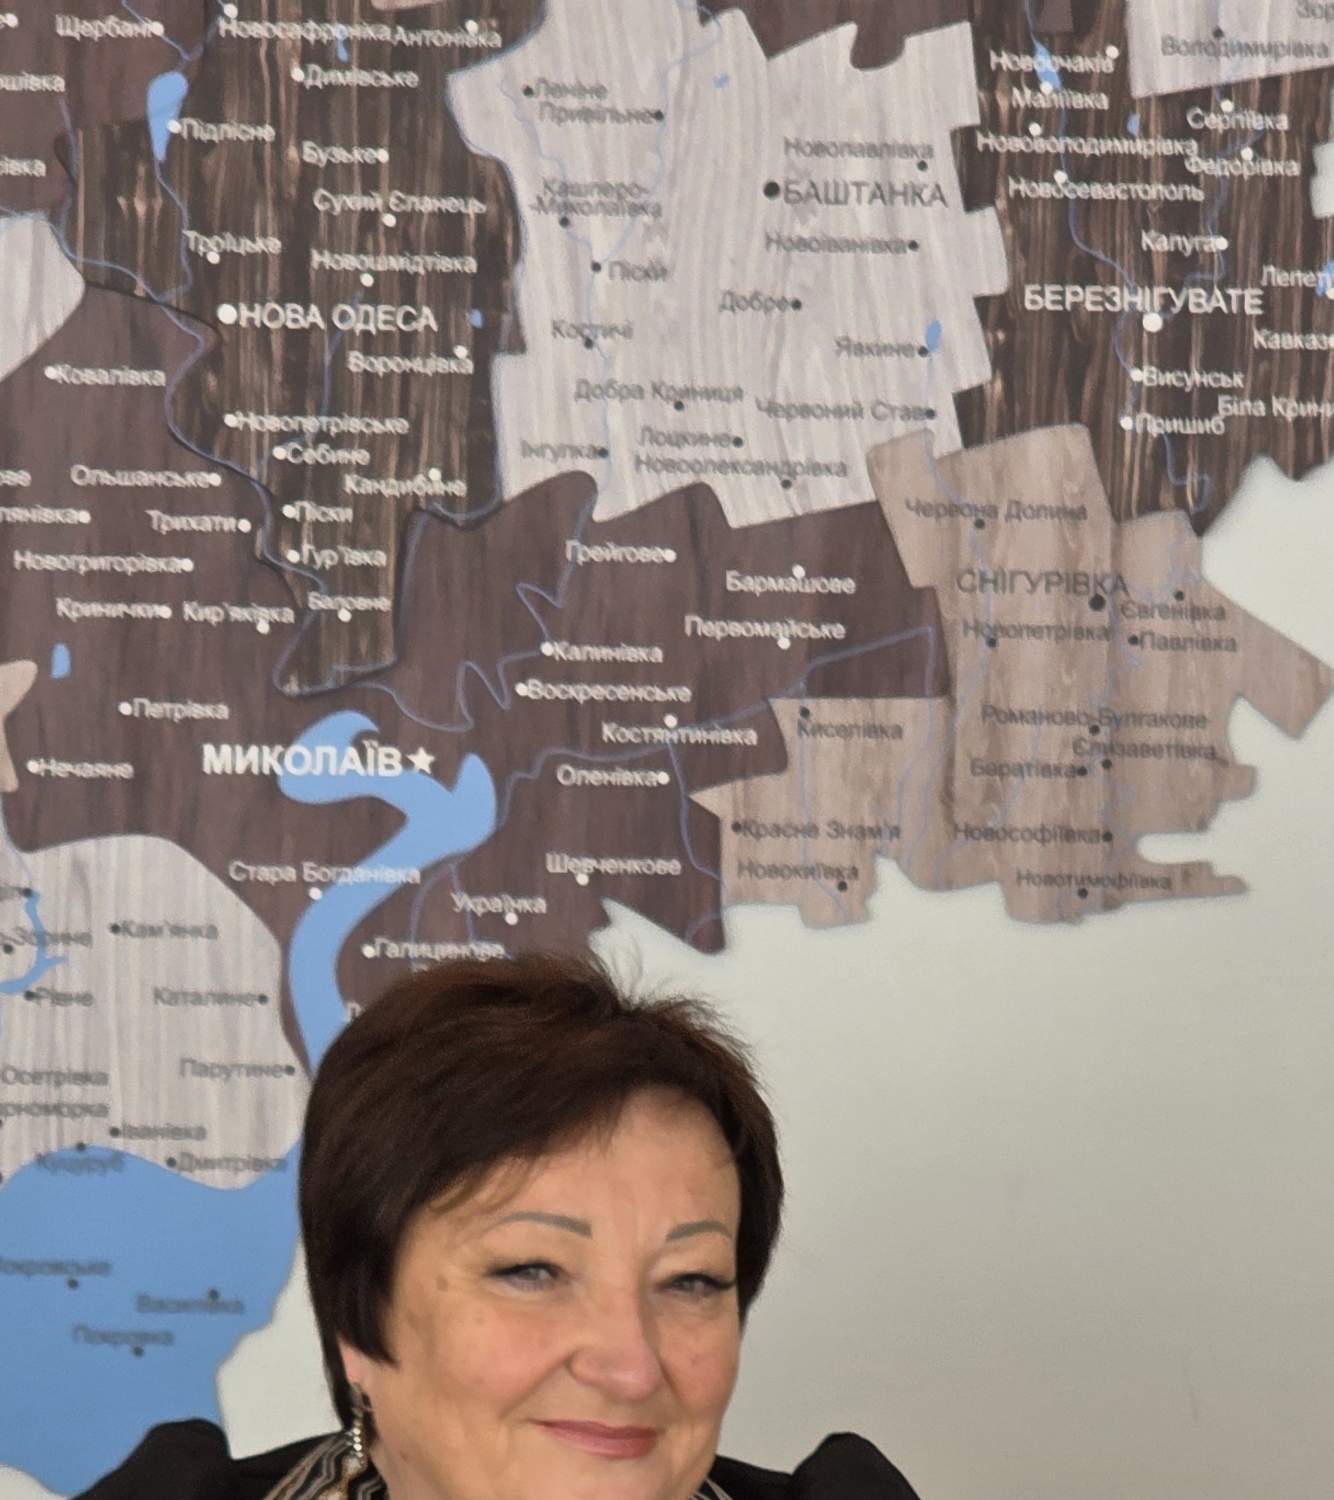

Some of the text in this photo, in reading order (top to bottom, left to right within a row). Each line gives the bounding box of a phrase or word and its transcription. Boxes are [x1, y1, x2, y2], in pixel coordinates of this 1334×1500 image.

[784, 182, 948, 208] БАШТАНКА
[1008, 179, 1204, 202] Новосевастополь
[1142, 231, 1215, 253] Калуга
[1025, 285, 1264, 315] БЕРЕЗНІГУВАТЕ
[240, 304, 437, 331] НОВА ОДЕСА
[1255, 330, 1330, 350] Кавказ
[1143, 367, 1244, 388] Висунськ
[1218, 396, 1265, 417] Біла
[237, 413, 408, 435] Новопетрівське
[1136, 413, 1225, 435] Пришиб
[956, 571, 1128, 596] СНІГУРІВКА
[685, 615, 846, 639] Первомайське
[555, 643, 662, 663] Калинівка
[528, 681, 692, 703] Воскресенське
[134, 700, 229, 721] Петрівка
[602, 723, 758, 746] Костянтинівка
[203, 739, 403, 776] МИКОЛАЇВ
[557, 765, 658, 786] Оленівка
[230, 862, 296, 884] Стара
